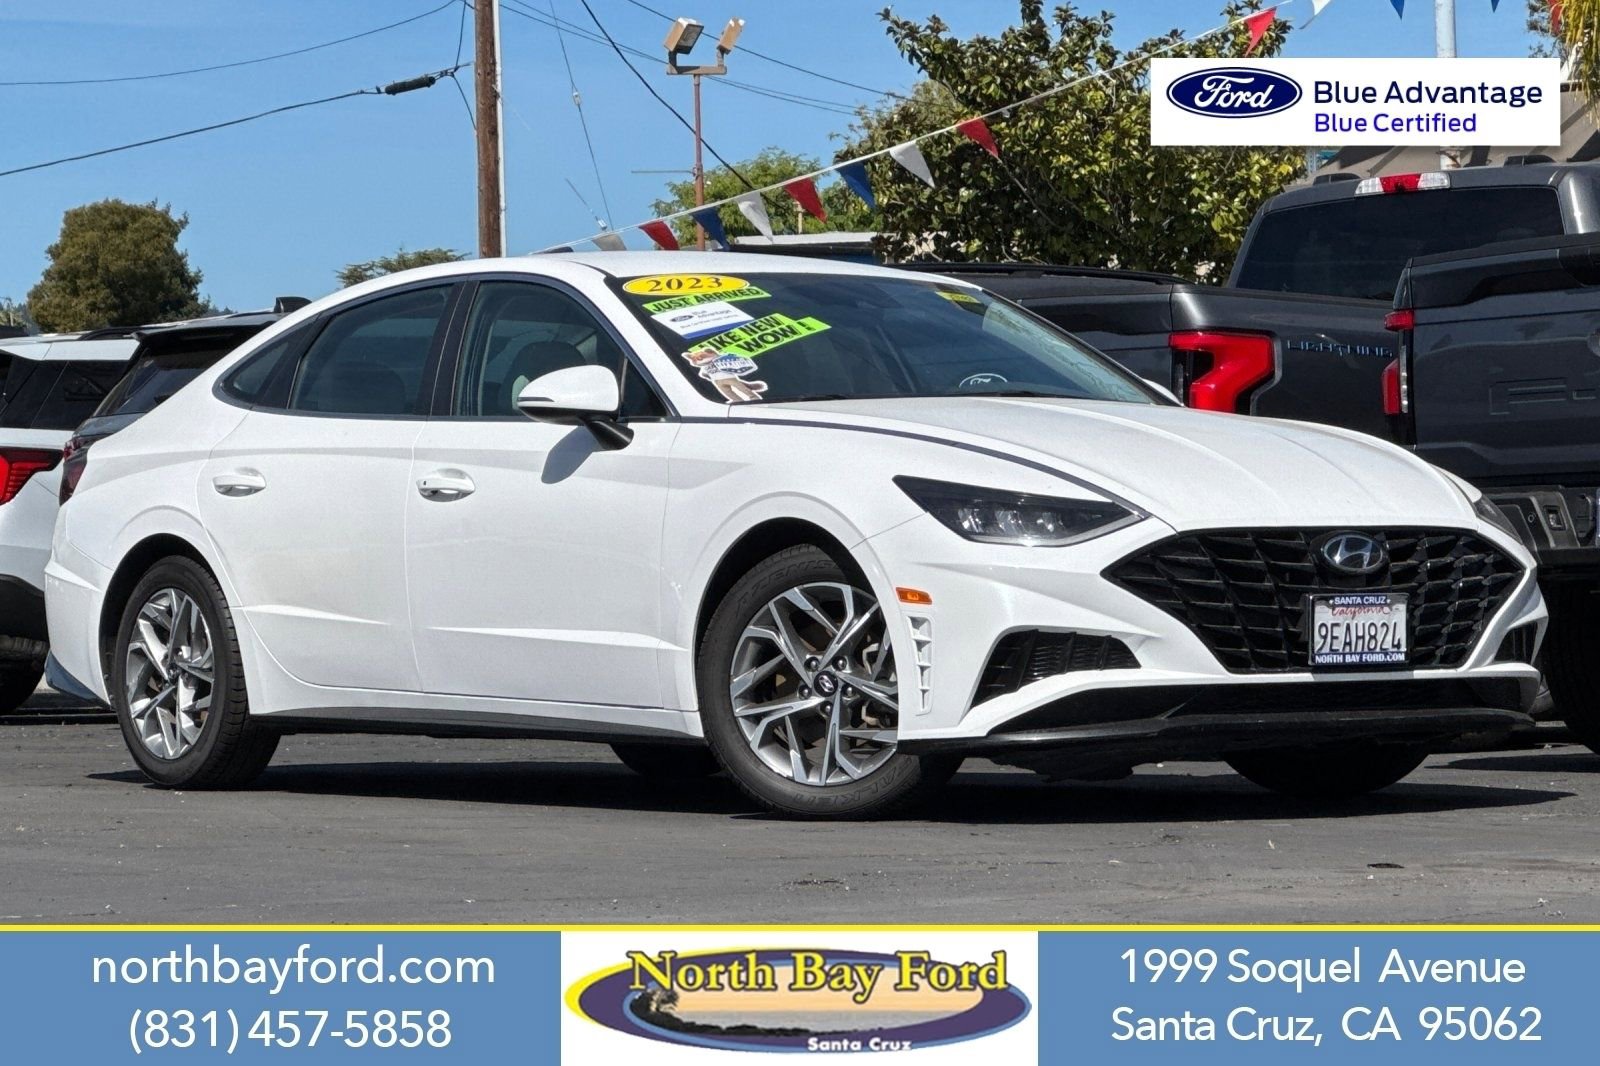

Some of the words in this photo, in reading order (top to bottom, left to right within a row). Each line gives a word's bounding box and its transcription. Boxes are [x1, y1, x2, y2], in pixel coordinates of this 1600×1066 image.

[645, 277, 723, 293] 2023
[652, 297, 691, 312] JUST
[696, 288, 763, 304] ARRIVED
[738, 316, 786, 337] NEW
[1287, 340, 1393, 357] LIGHTNING
[1334, 596, 1362, 605] SANTA
[1363, 596, 1387, 604] CRUZ
[1316, 622, 1402, 653] 9EAH824
[1315, 653, 1343, 664] NORTH
[1345, 653, 1361, 663] BAY
[1362, 652, 1405, 663] FORD.COM
